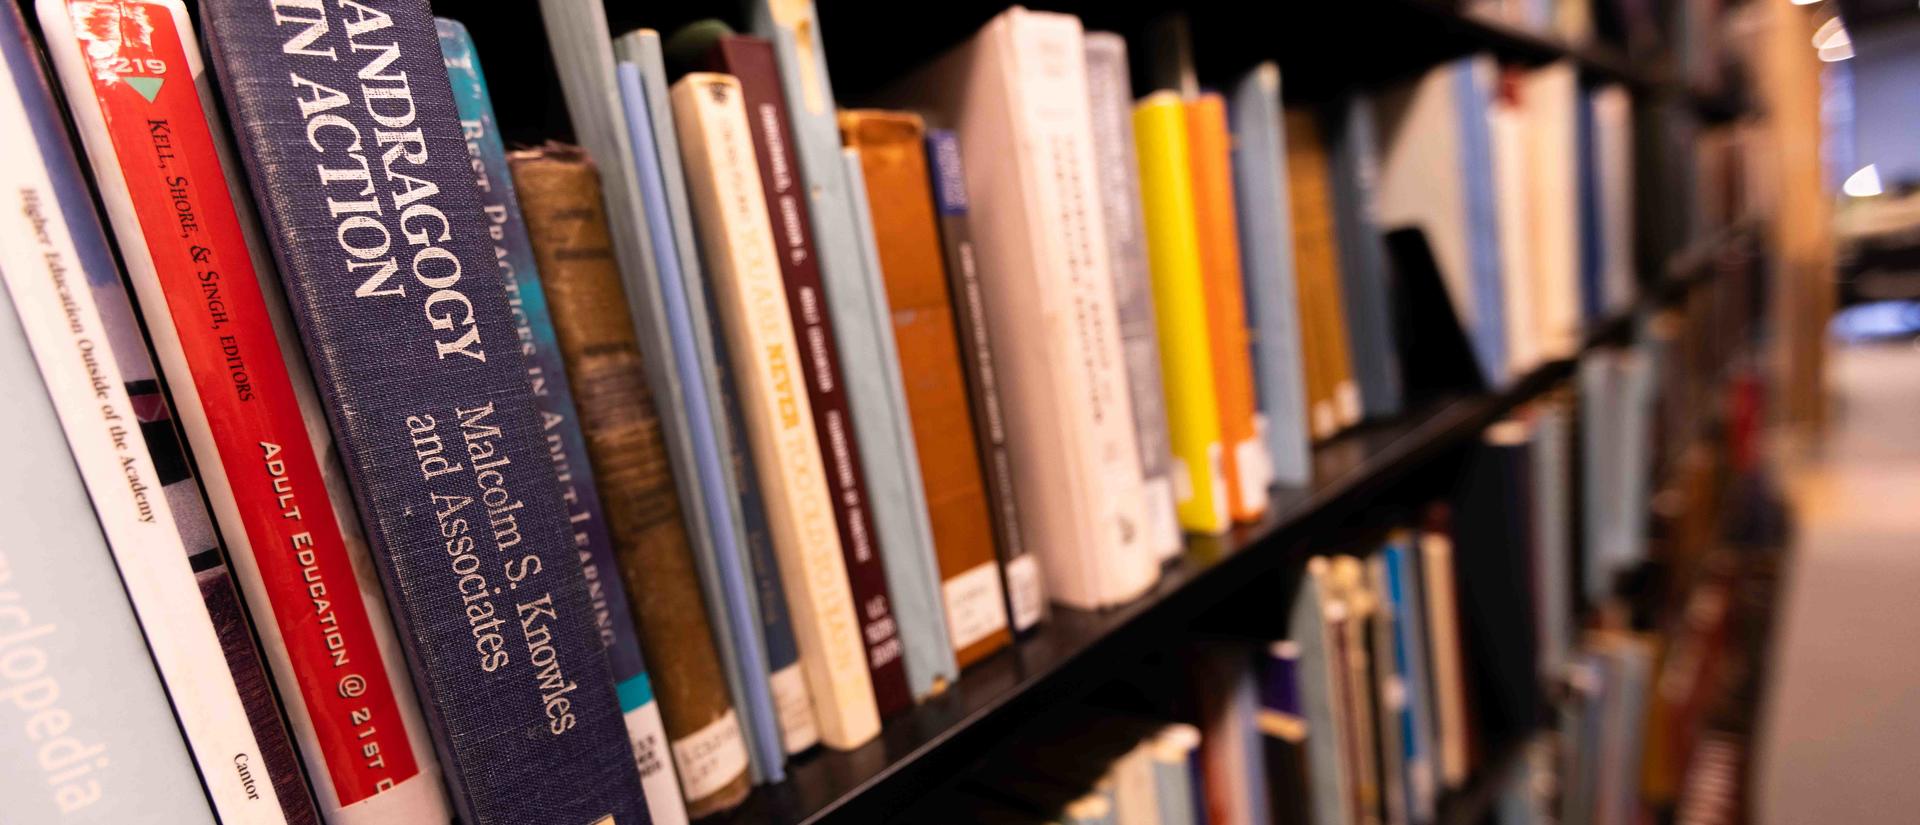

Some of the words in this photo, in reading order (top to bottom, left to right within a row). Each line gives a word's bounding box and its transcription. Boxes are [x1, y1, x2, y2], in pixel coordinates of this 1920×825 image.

[272, 0, 338, 62] IN
[290, 72, 405, 299] ACTION
[337, 0, 486, 363] ANDRAGOGY
[20, 187, 53, 246] Higher
[45, 251, 83, 335] Education
[190, 245, 210, 264] &
[220, 334, 254, 402] EDITORS
[78, 338, 111, 398] Outside
[102, 396, 123, 422] of
[110, 425, 129, 452] the
[260, 441, 302, 520] ADULT
[406, 414, 463, 481] and
[455, 401, 524, 551] Malcolm
[121, 456, 156, 524] Academy
[291, 532, 350, 667] EDUCATION
[430, 492, 510, 674] Associates
[504, 554, 543, 590] S.
[337, 673, 367, 698] @
[516, 592, 578, 736] Knowles
[350, 706, 386, 769] 21ST
[233, 752, 260, 801] Cantor
